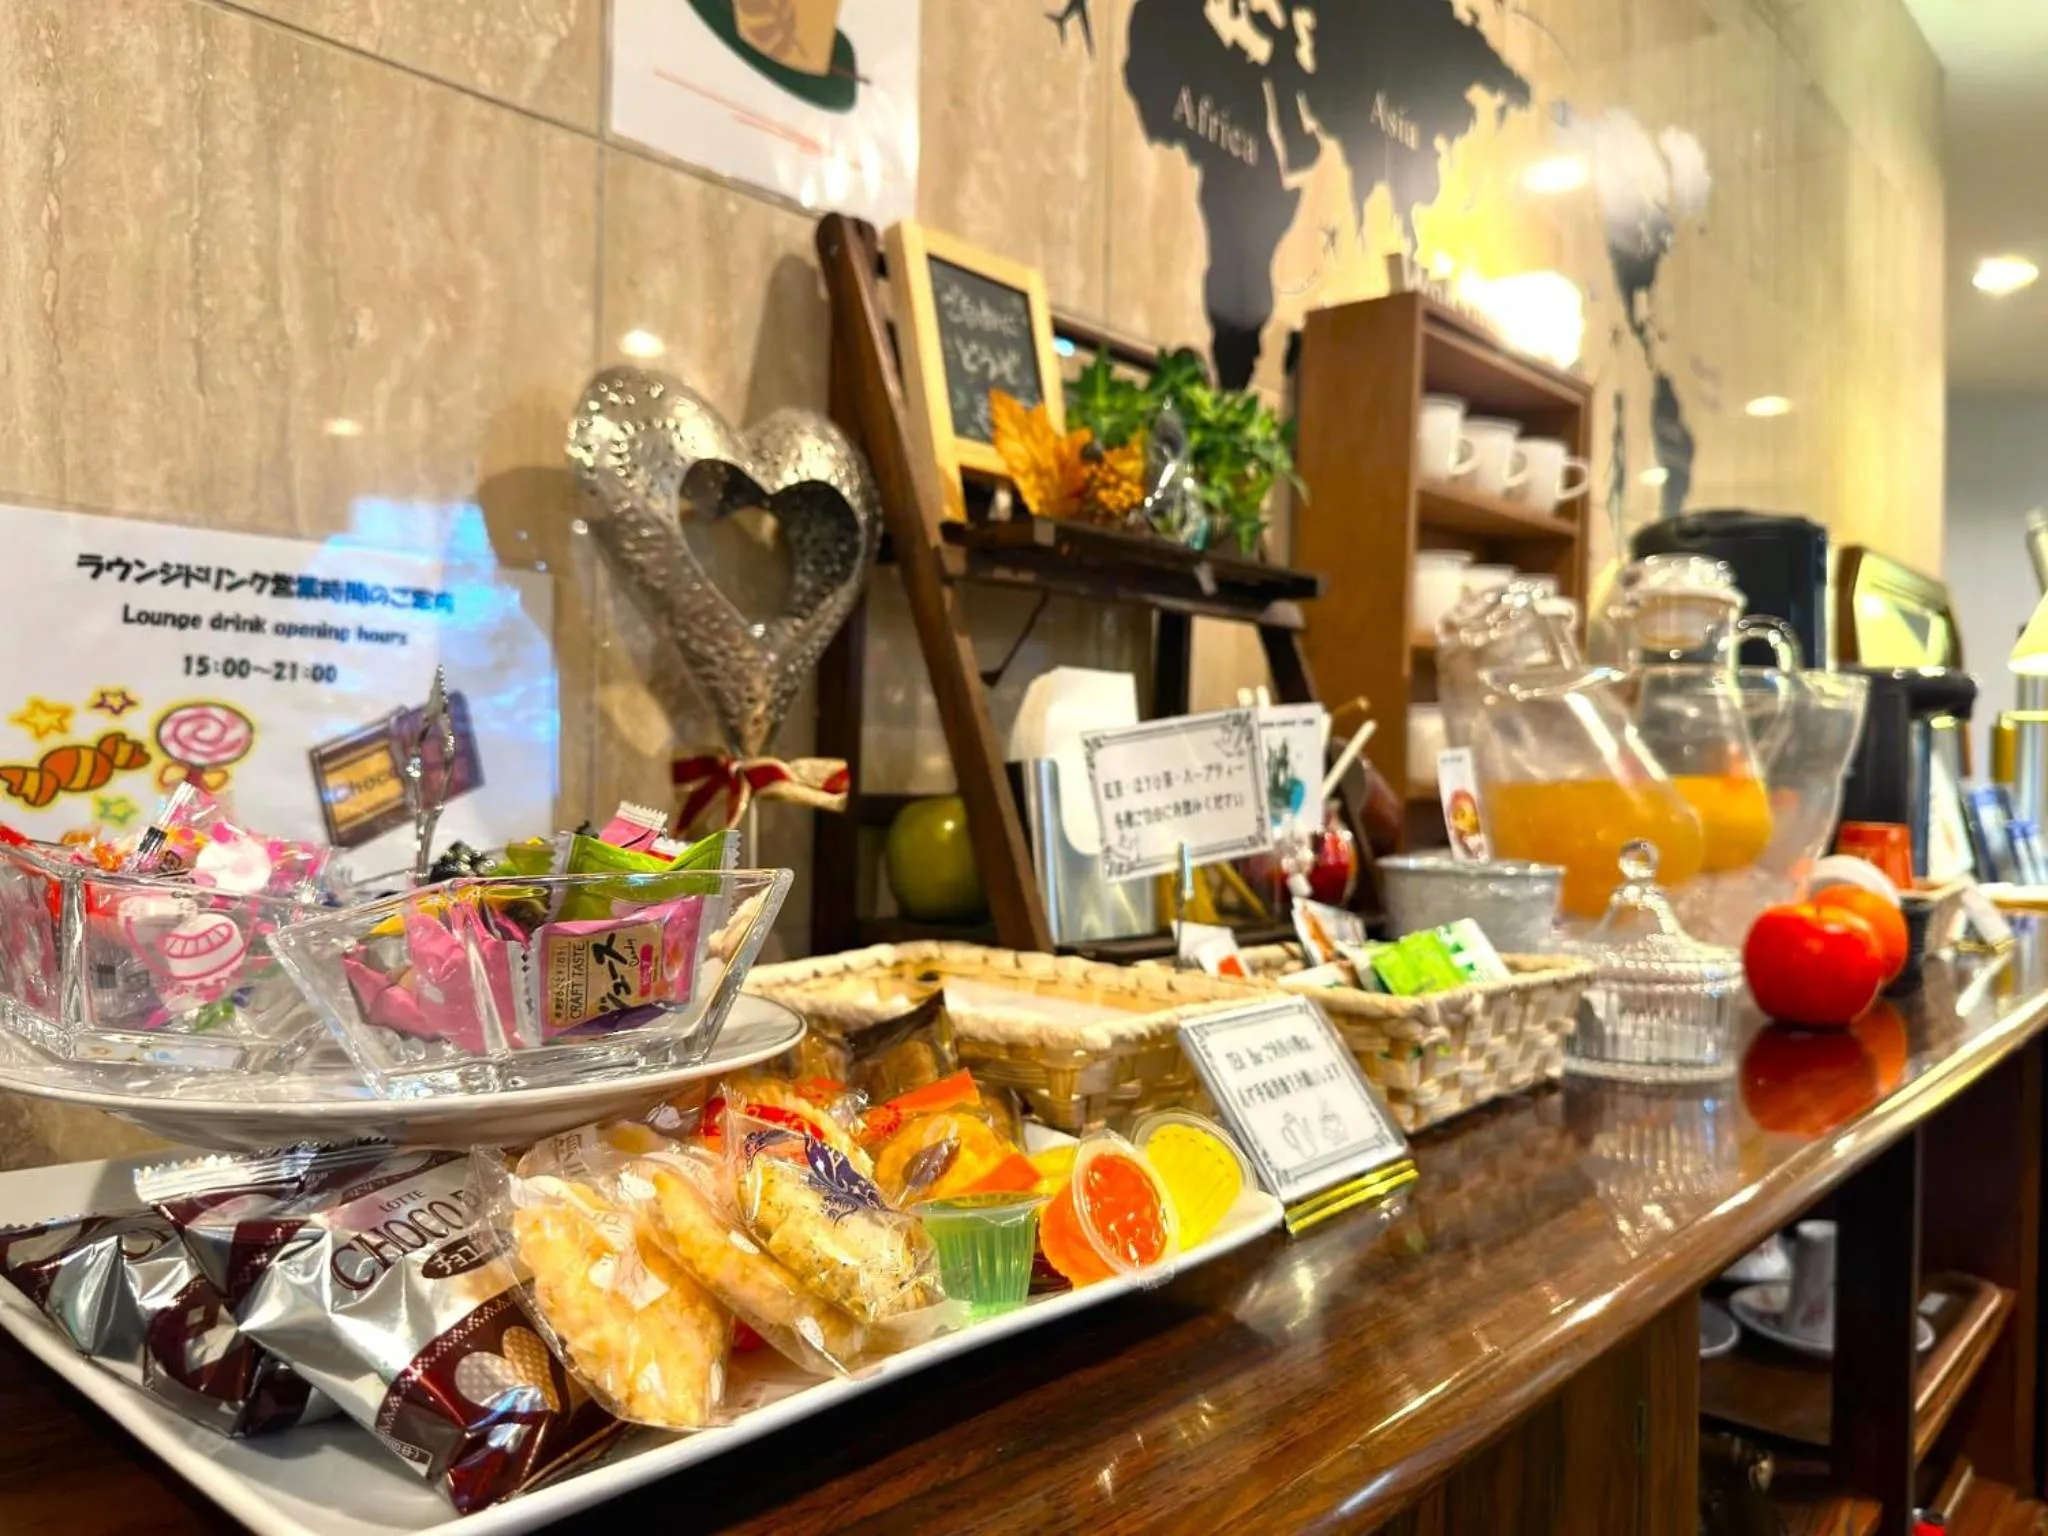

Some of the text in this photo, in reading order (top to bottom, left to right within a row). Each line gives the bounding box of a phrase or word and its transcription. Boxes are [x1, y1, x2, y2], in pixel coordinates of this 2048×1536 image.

[1173, 85, 1258, 167] Africa
[1370, 91, 1420, 151] Asia
[122, 604, 409, 646] Lounge drink opening hours
[569, 942, 585, 1019] CRAFT TASTE
[592, 932, 632, 1013] ジュース
[378, 1190, 426, 1213] LOTTE
